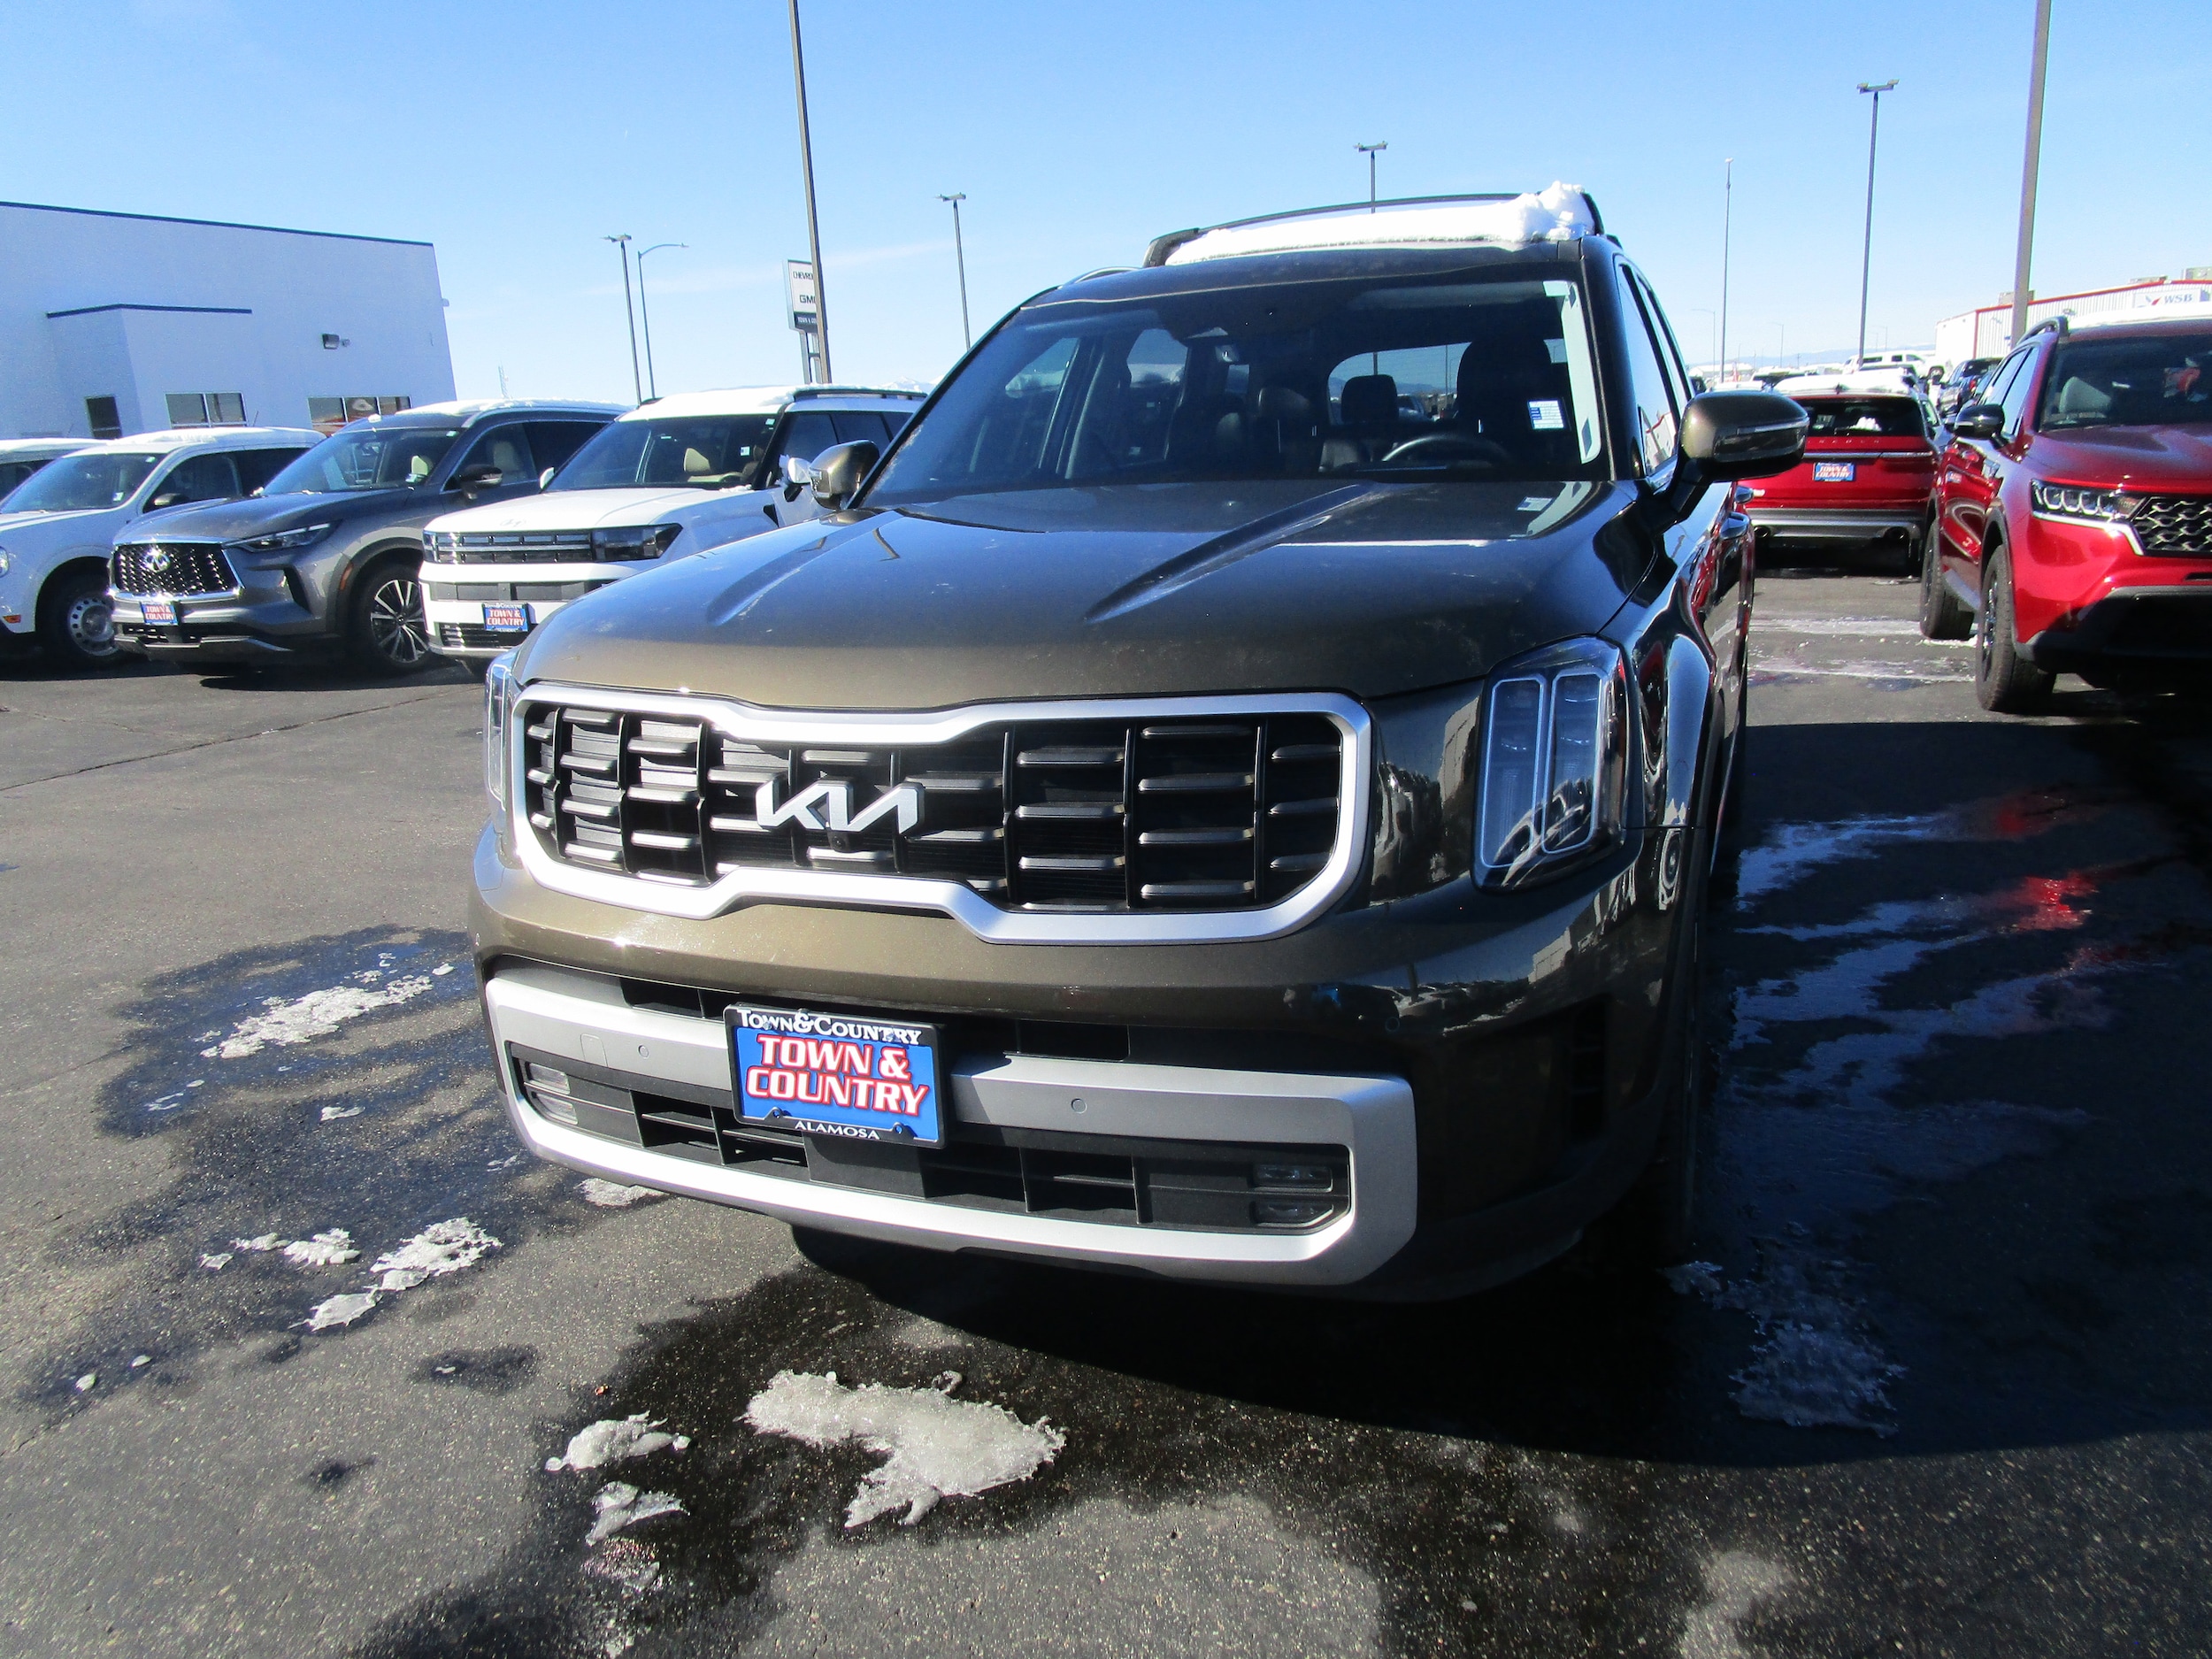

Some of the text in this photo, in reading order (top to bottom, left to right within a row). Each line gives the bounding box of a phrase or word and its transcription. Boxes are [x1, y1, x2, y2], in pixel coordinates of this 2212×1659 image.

[793, 271, 813, 280] CHEVRO
[799, 294, 816, 304] GM
[489, 609, 521, 618] TOWN &
[487, 617, 525, 626] COUNTRY
[756, 780, 926, 834] KIA
[757, 1033, 911, 1081] TOWN &
[746, 1066, 929, 1117] COUNTRY
[795, 1120, 879, 1140] ALAMOSA
